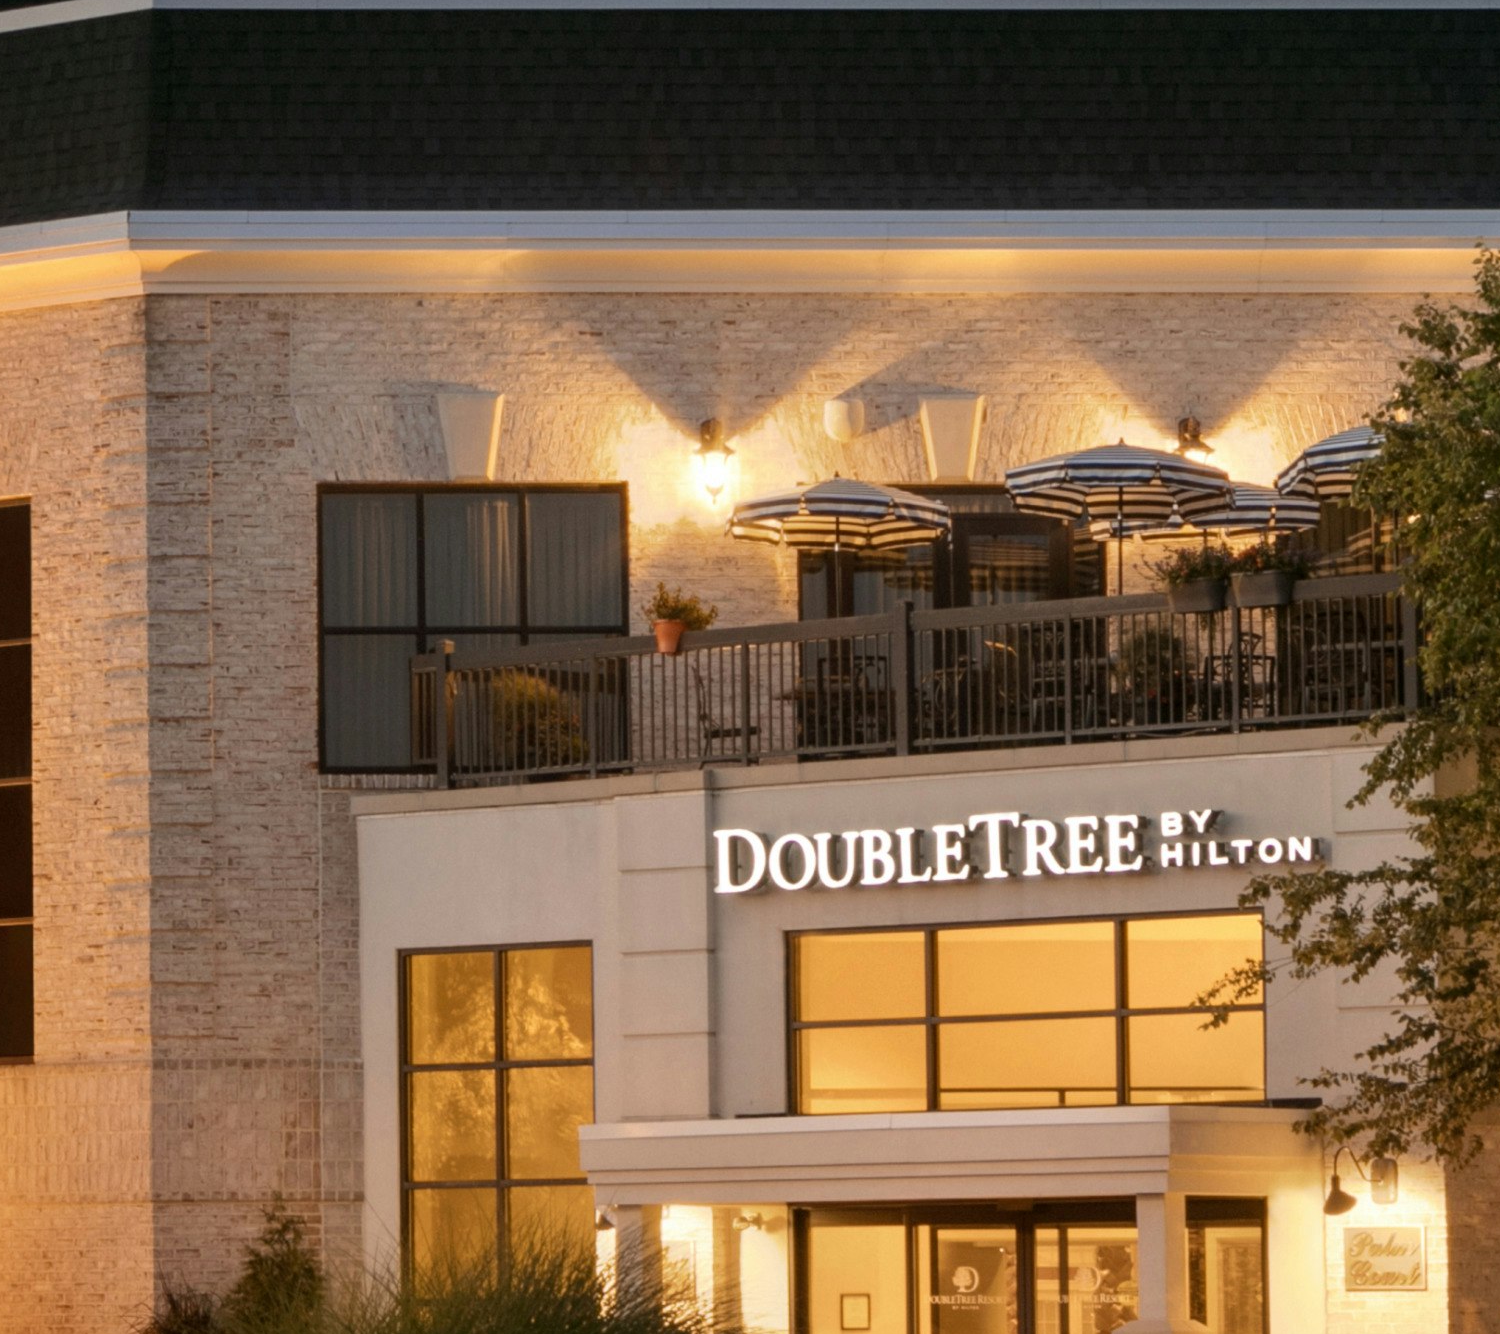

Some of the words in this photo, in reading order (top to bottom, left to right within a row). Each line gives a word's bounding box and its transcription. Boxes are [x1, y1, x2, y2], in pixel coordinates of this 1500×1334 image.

[1160, 808, 1212, 837] BY
[713, 811, 1143, 894] DOUBLETREE
[1160, 836, 1312, 868] HILTON
